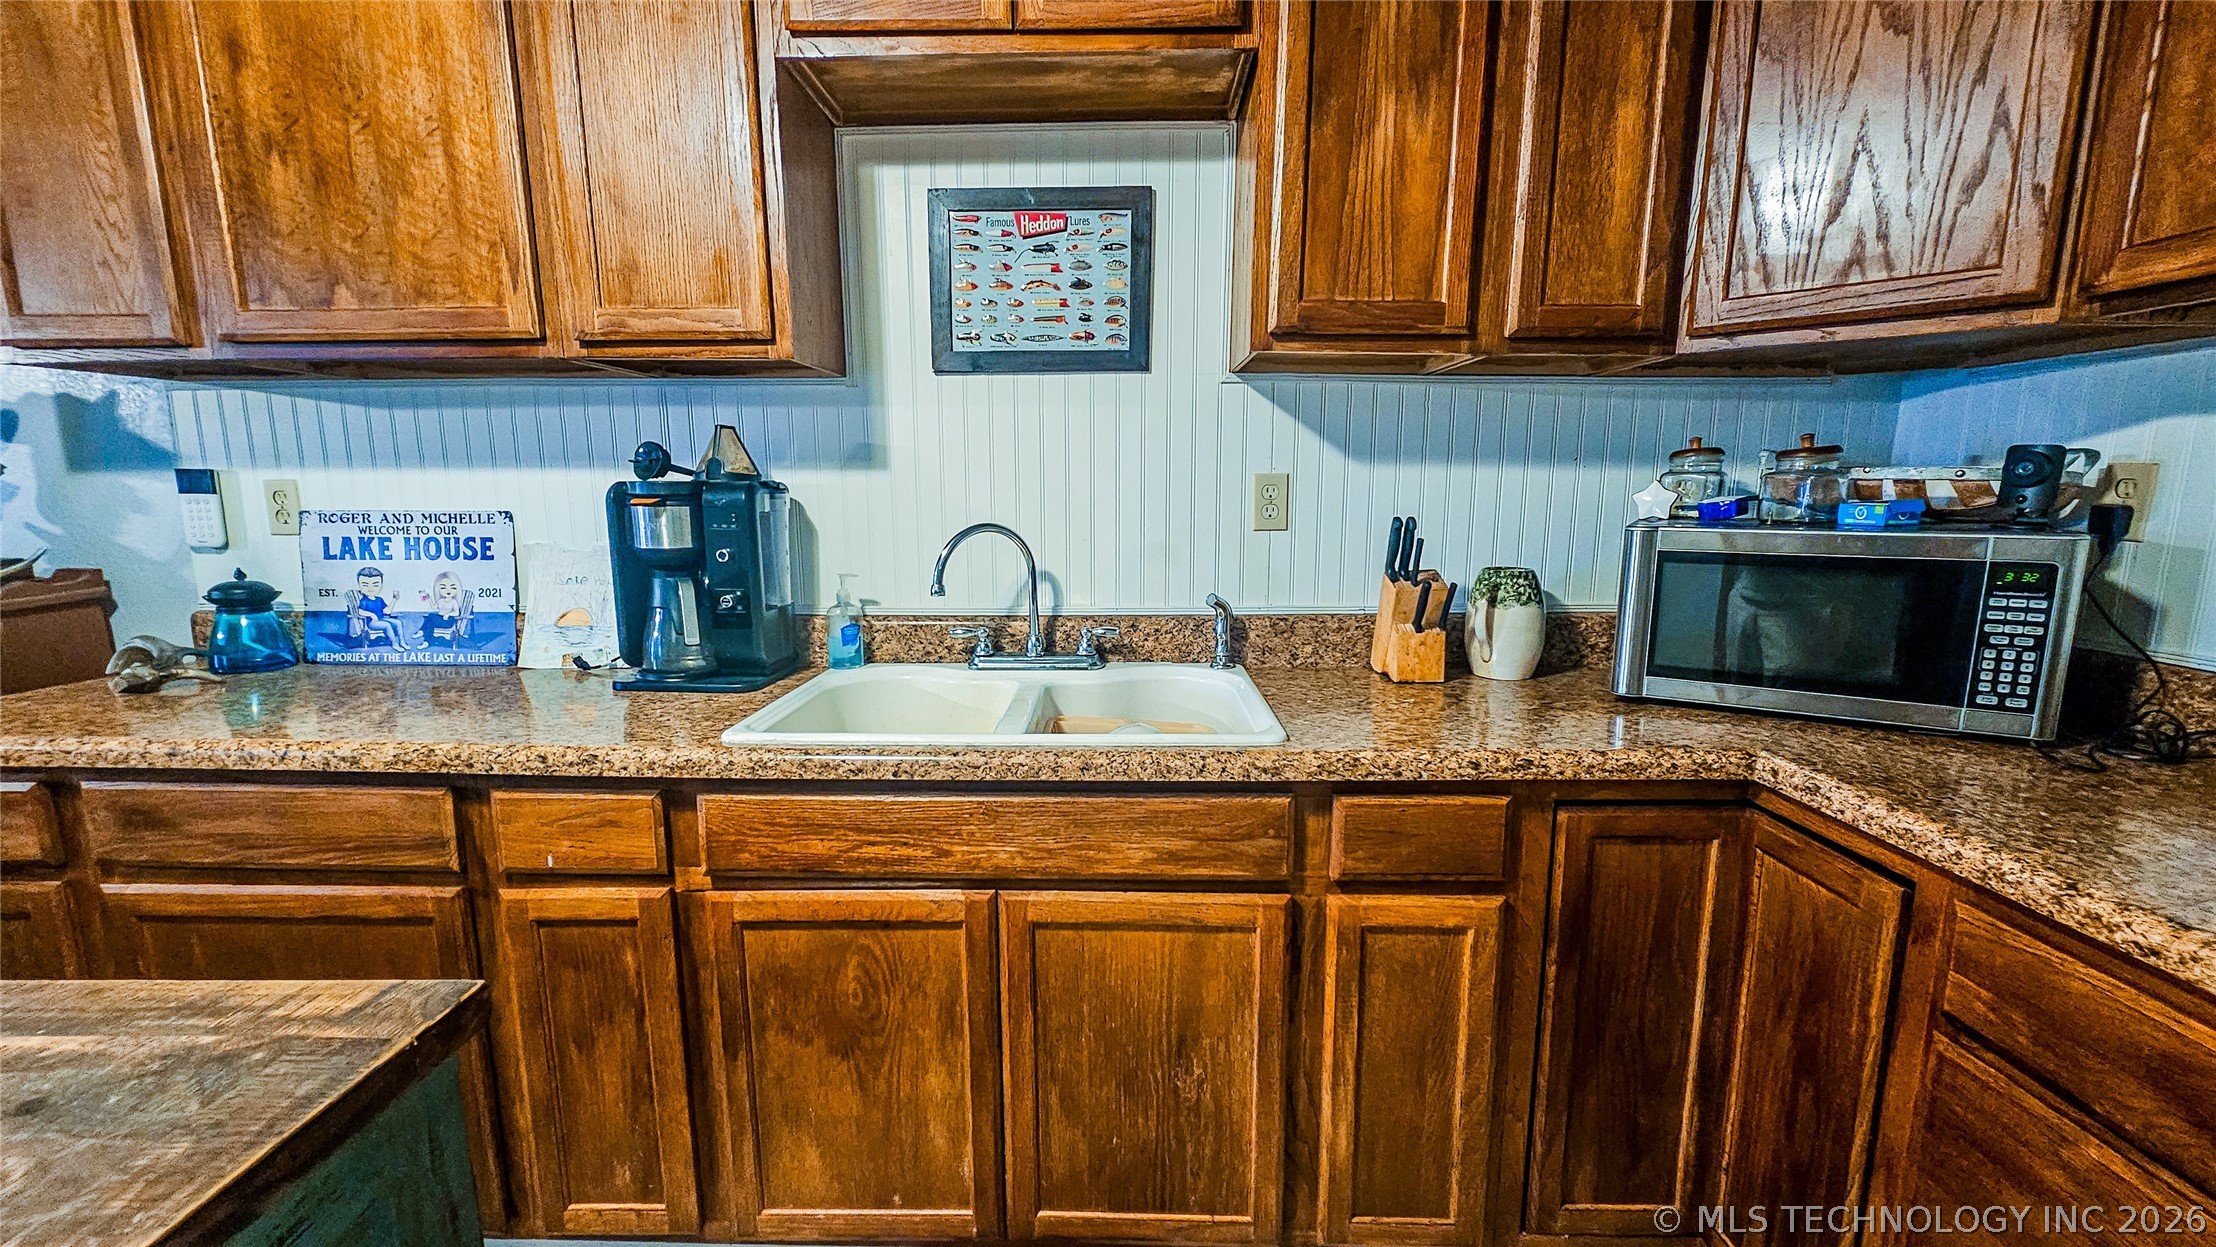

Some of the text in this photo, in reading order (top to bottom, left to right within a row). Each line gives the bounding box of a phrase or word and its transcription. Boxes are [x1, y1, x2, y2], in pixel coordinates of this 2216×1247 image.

[985, 213, 1091, 236] Famous Heddon Lures
[317, 512, 496, 525] ROGER AND MICHELLE
[357, 525, 459, 536] WELCOME TO OUR
[321, 536, 495, 561] LAKE HOUSE
[318, 588, 338, 598] EST.
[478, 588, 502, 598] 2021
[317, 652, 507, 663] MEMORIES AT THE LAKE LAST A LIFETIME
